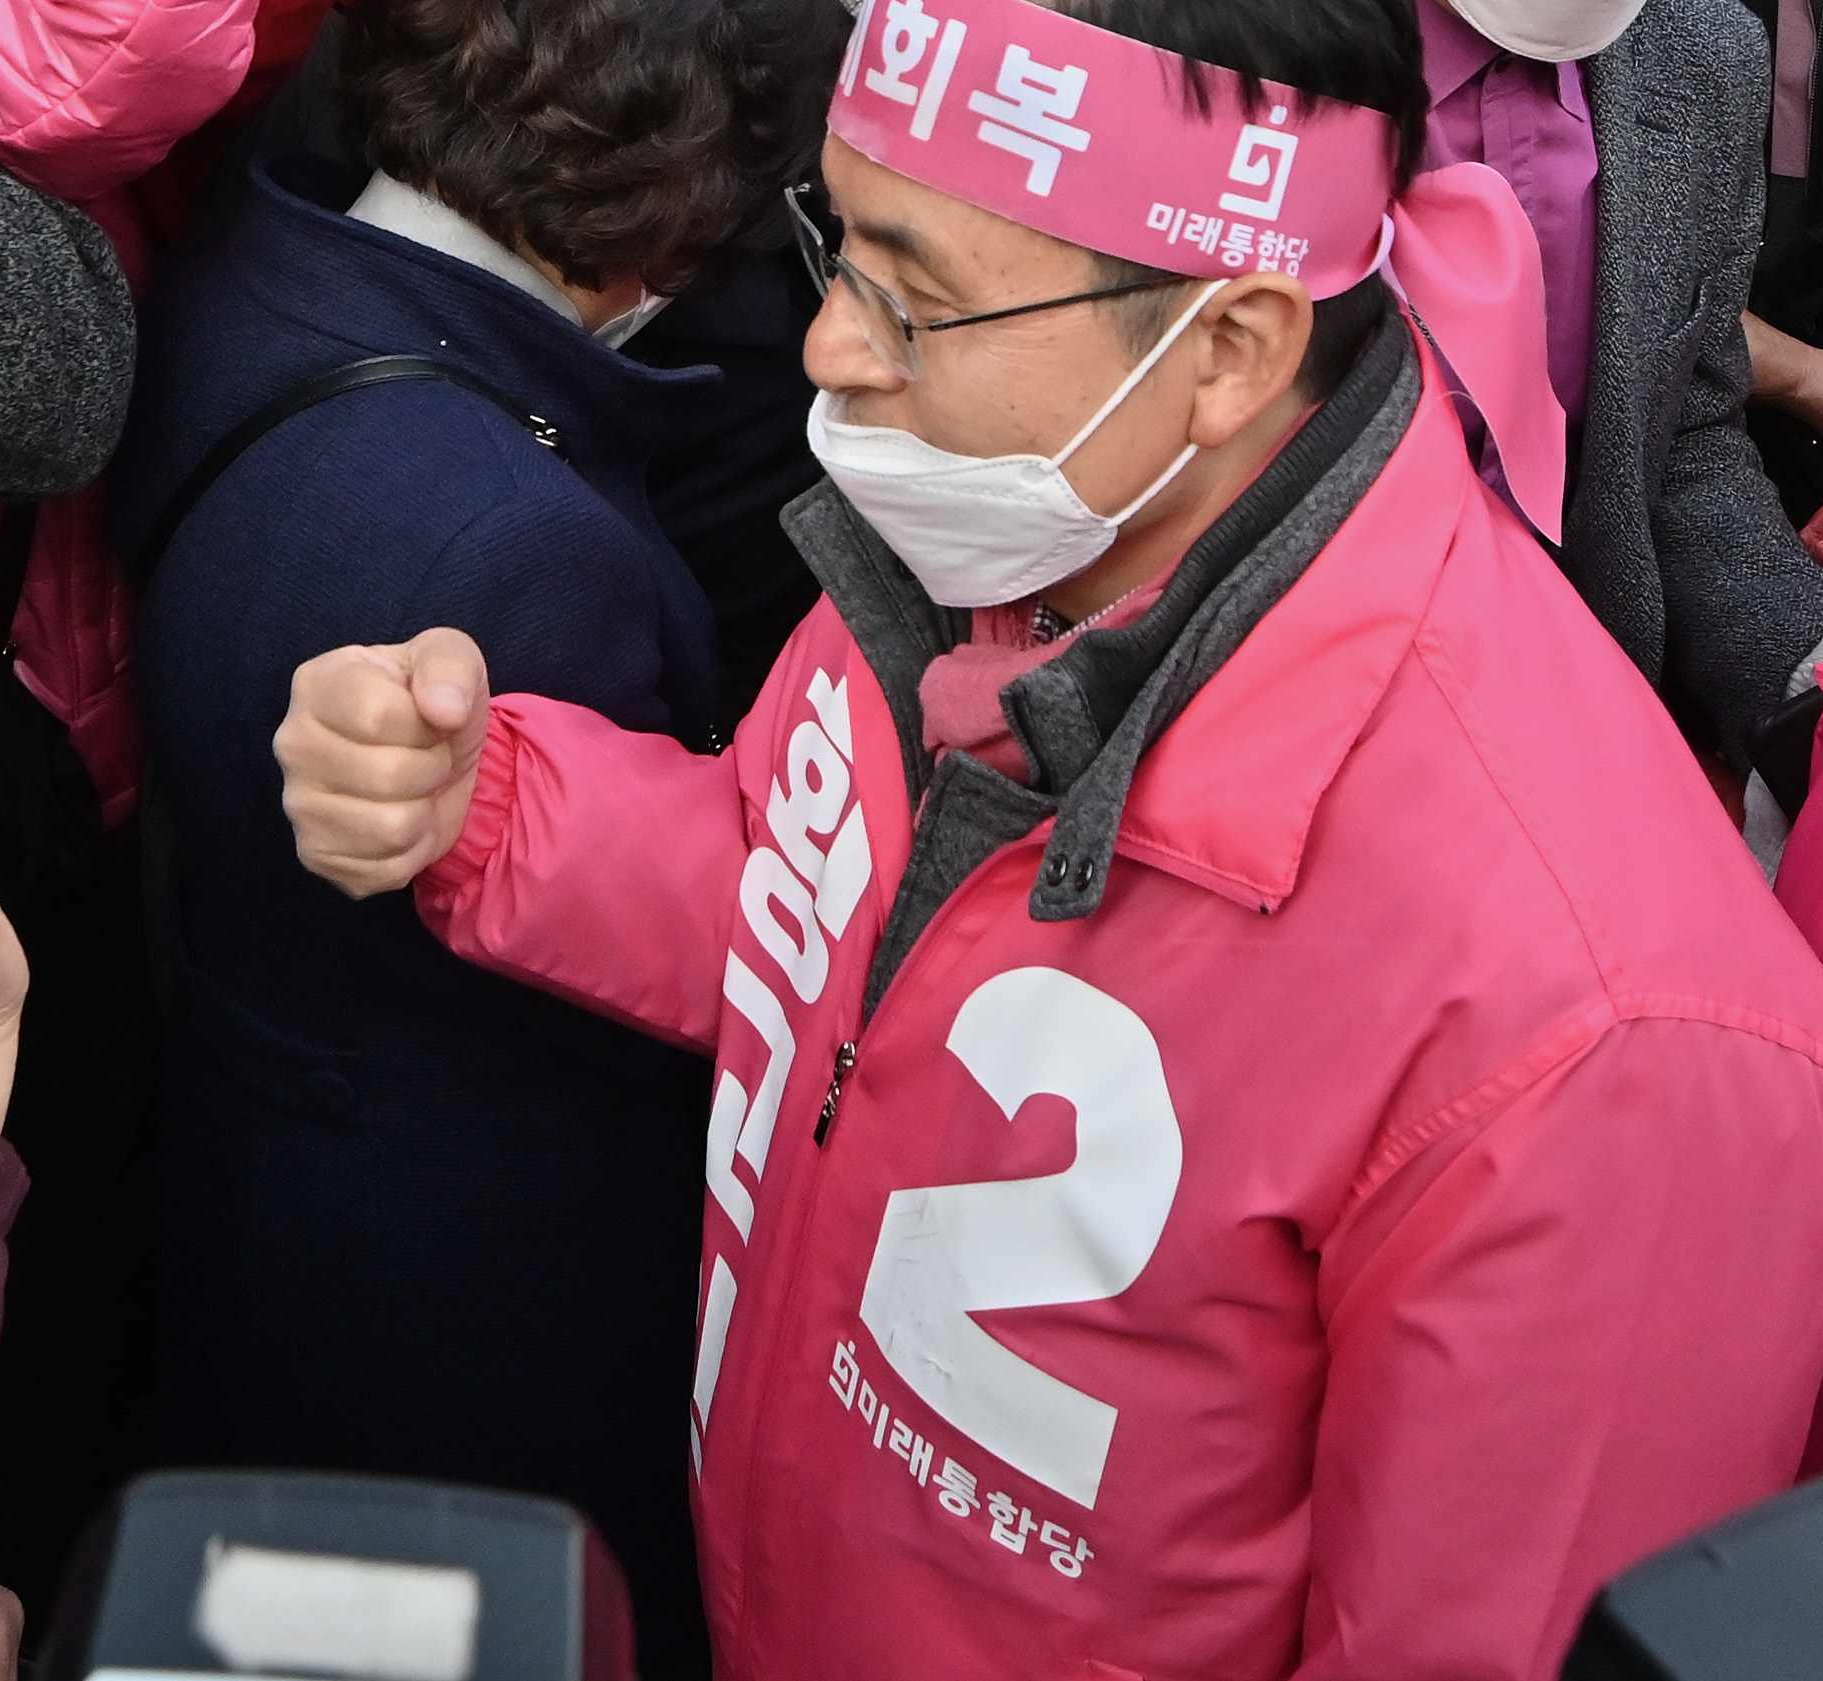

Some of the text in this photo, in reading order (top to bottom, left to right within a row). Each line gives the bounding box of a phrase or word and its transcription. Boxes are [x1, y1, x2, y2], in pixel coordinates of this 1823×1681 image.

[1145, 202, 1310, 278] 미래통합당
[859, 966, 1184, 1511] 2
[857, 1378, 1095, 1579] 미래통합당
